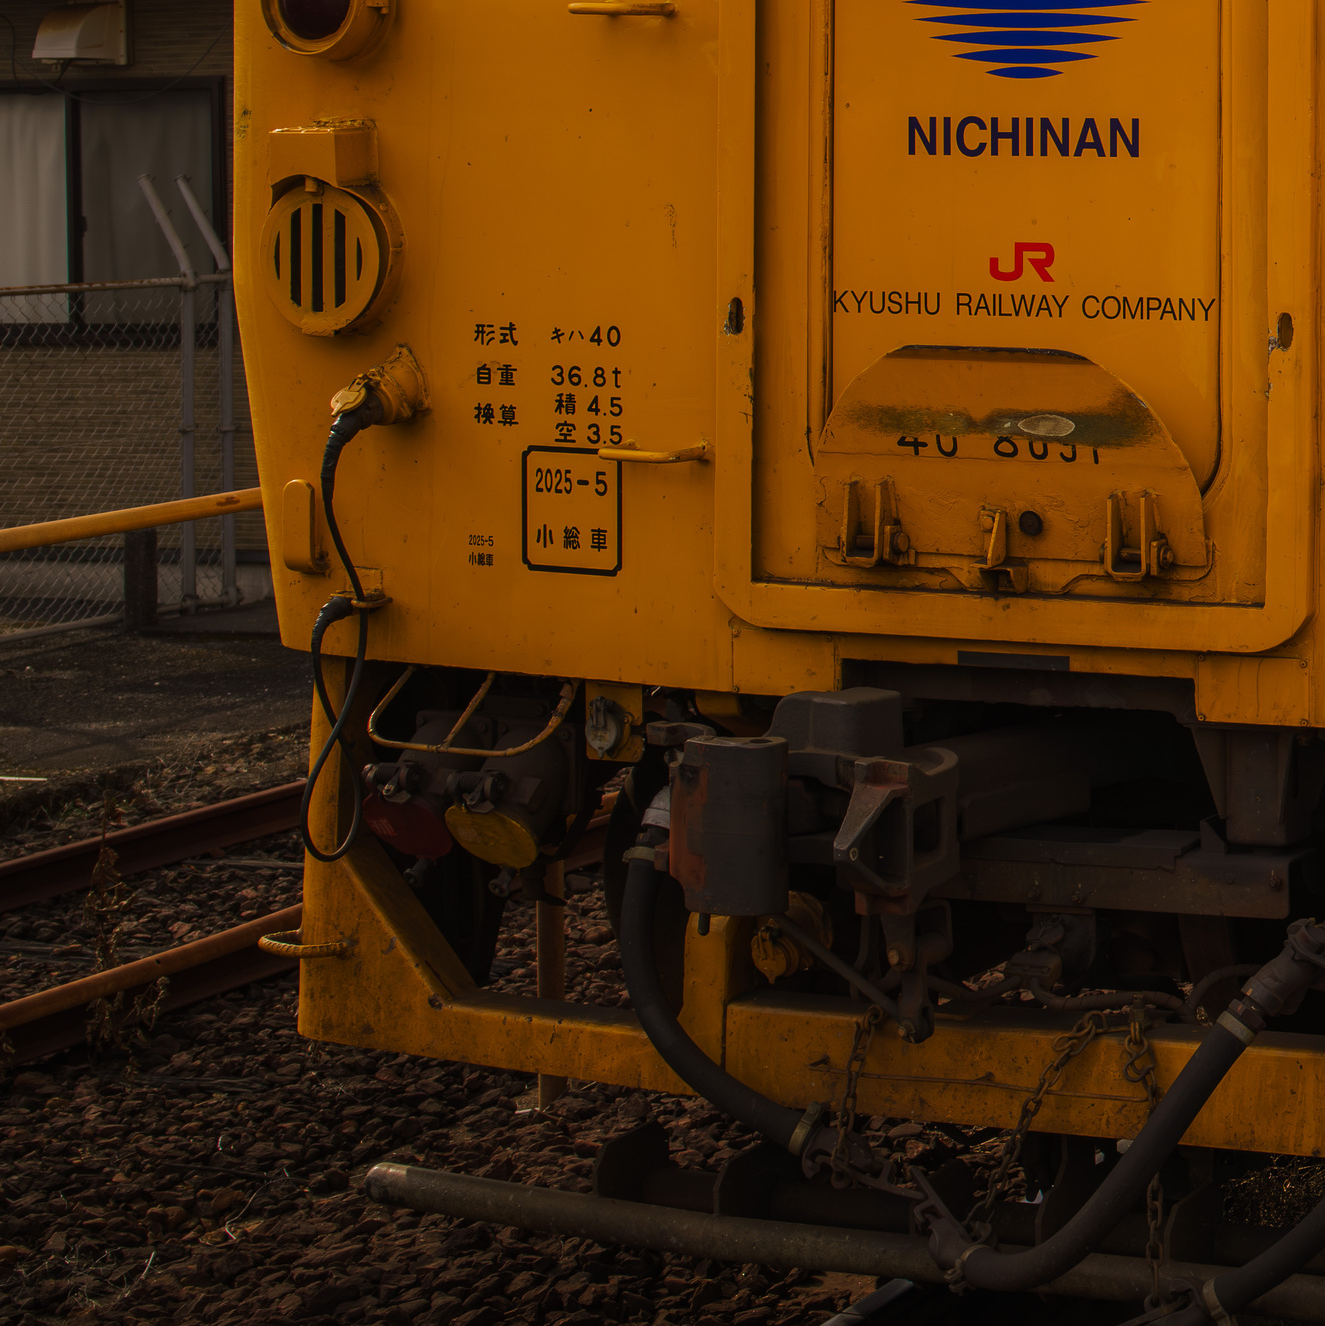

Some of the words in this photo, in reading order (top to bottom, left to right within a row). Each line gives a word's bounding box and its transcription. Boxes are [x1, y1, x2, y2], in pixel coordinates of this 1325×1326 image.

[908, 115, 1140, 158] NICHINAN
[989, 242, 1055, 283] JR
[833, 290, 941, 315] KYUSHU
[956, 293, 1070, 318] RAILWAY
[1082, 295, 1216, 322] COMPANY
[474, 322, 518, 346] 形式
[551, 325, 621, 347] キハ40
[476, 363, 518, 386] 自重
[474, 402, 519, 426] 換算
[554, 392, 577, 415] 積
[587, 395, 623, 417] 4.5
[554, 420, 577, 443] 空
[587, 423, 623, 445] 3.5
[535, 467, 608, 496] 2025-5
[468, 534, 494, 547] 2025-5
[536, 524, 608, 552] 小総車
